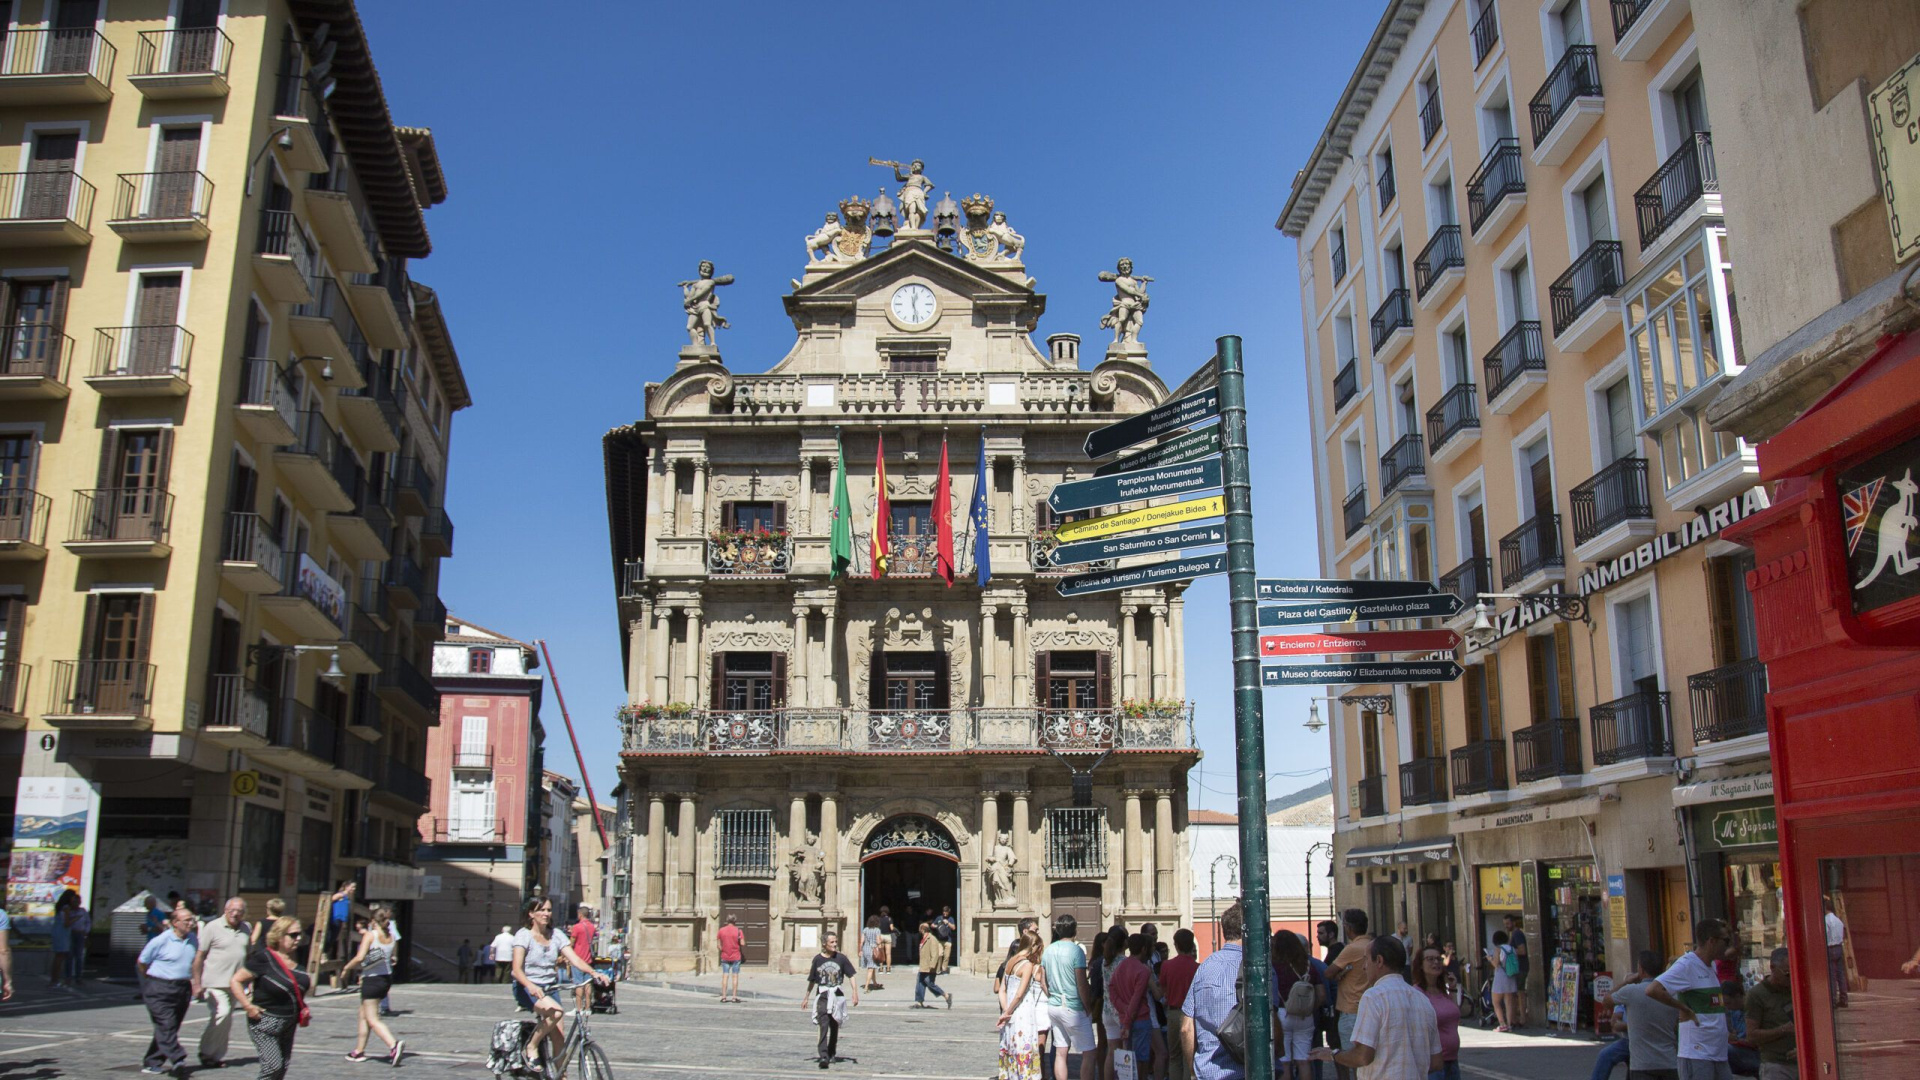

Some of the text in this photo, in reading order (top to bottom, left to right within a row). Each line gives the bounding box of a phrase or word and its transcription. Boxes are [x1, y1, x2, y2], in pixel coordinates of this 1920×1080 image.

[1151, 410, 1171, 421] Museo
[1172, 406, 1180, 414] de
[1181, 397, 1206, 411] Navarra
[1147, 408, 1206, 434] Nafarroako Museoa
[1120, 432, 1209, 470] Museo de Educación Ambiental
[1185, 444, 1210, 457] Museoa
[1117, 465, 1204, 487] Pamplona Monumental
[1120, 477, 1205, 497] Iruñeko Monumentuak
[1073, 523, 1099, 534] Camino
[1100, 521, 1109, 529] de
[1110, 516, 1141, 529] Santiago
[1146, 509, 1184, 522] Donejakue
[1185, 504, 1207, 514] Bidea
[1103, 545, 1118, 553] San
[1119, 538, 1156, 551] Saturnino
[1164, 535, 1180, 544] San
[1181, 531, 1208, 541] Cernin
[1074, 577, 1100, 589] Oficina
[1101, 575, 1111, 584] de
[1112, 572, 1141, 583] Turismo
[1147, 567, 1177, 578] Turismo
[1178, 562, 1210, 575] Bulegoa
[1465, 584, 1561, 654] EIZARI
[1578, 485, 1772, 599] INMOBILIARIA
[1274, 584, 1309, 593] Catedral
[1315, 585, 1353, 594] Katedrala
[1278, 610, 1302, 619] Plaza
[1303, 608, 1317, 617] del
[1319, 607, 1352, 617] Castillo
[1359, 604, 1404, 613] Gazteluko
[1405, 602, 1430, 612] plaza
[1280, 641, 1315, 649] Encierro
[1323, 639, 1367, 648] Entzierroa
[1281, 670, 1309, 679] Museo
[1311, 668, 1352, 678] diocesano
[1359, 667, 1408, 676] Elizbarrutiko
[1409, 667, 1442, 675] museoa
[1495, 813, 1534, 827] ALIMENTACIÓN
[1721, 818, 1778, 838] Mª Sagrari
[1647, 837, 1655, 854] 2
